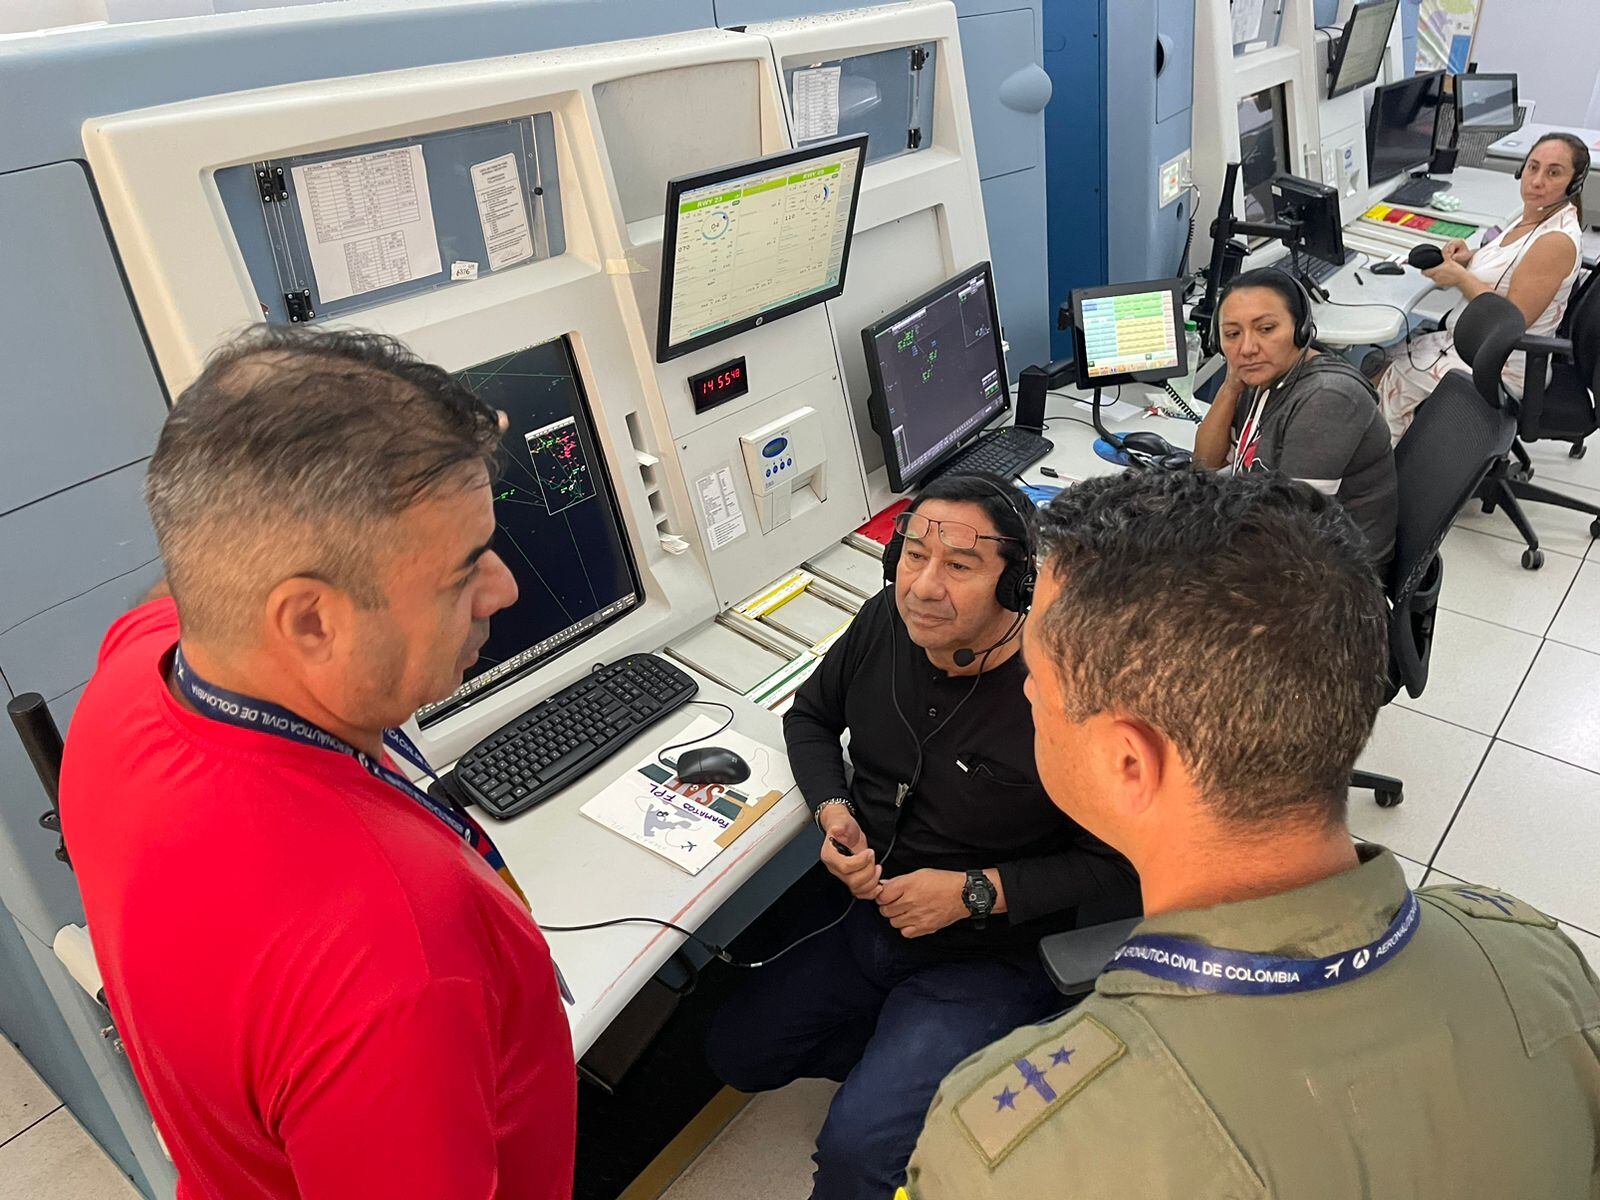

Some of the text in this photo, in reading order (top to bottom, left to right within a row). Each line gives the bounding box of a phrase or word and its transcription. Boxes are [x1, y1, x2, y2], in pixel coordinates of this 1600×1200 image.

[697, 199, 713, 208] RWY
[703, 379, 714, 394] 14
[717, 372, 731, 389] 55
[191, 683, 239, 716] COLOMBIA
[240, 705, 259, 722] DE
[260, 710, 288, 731] CIVIL
[649, 782, 677, 803] FPL
[1170, 953, 1201, 974] CIVIL
[1202, 960, 1223, 978] DE
[1225, 966, 1301, 984] COLOMBIA
